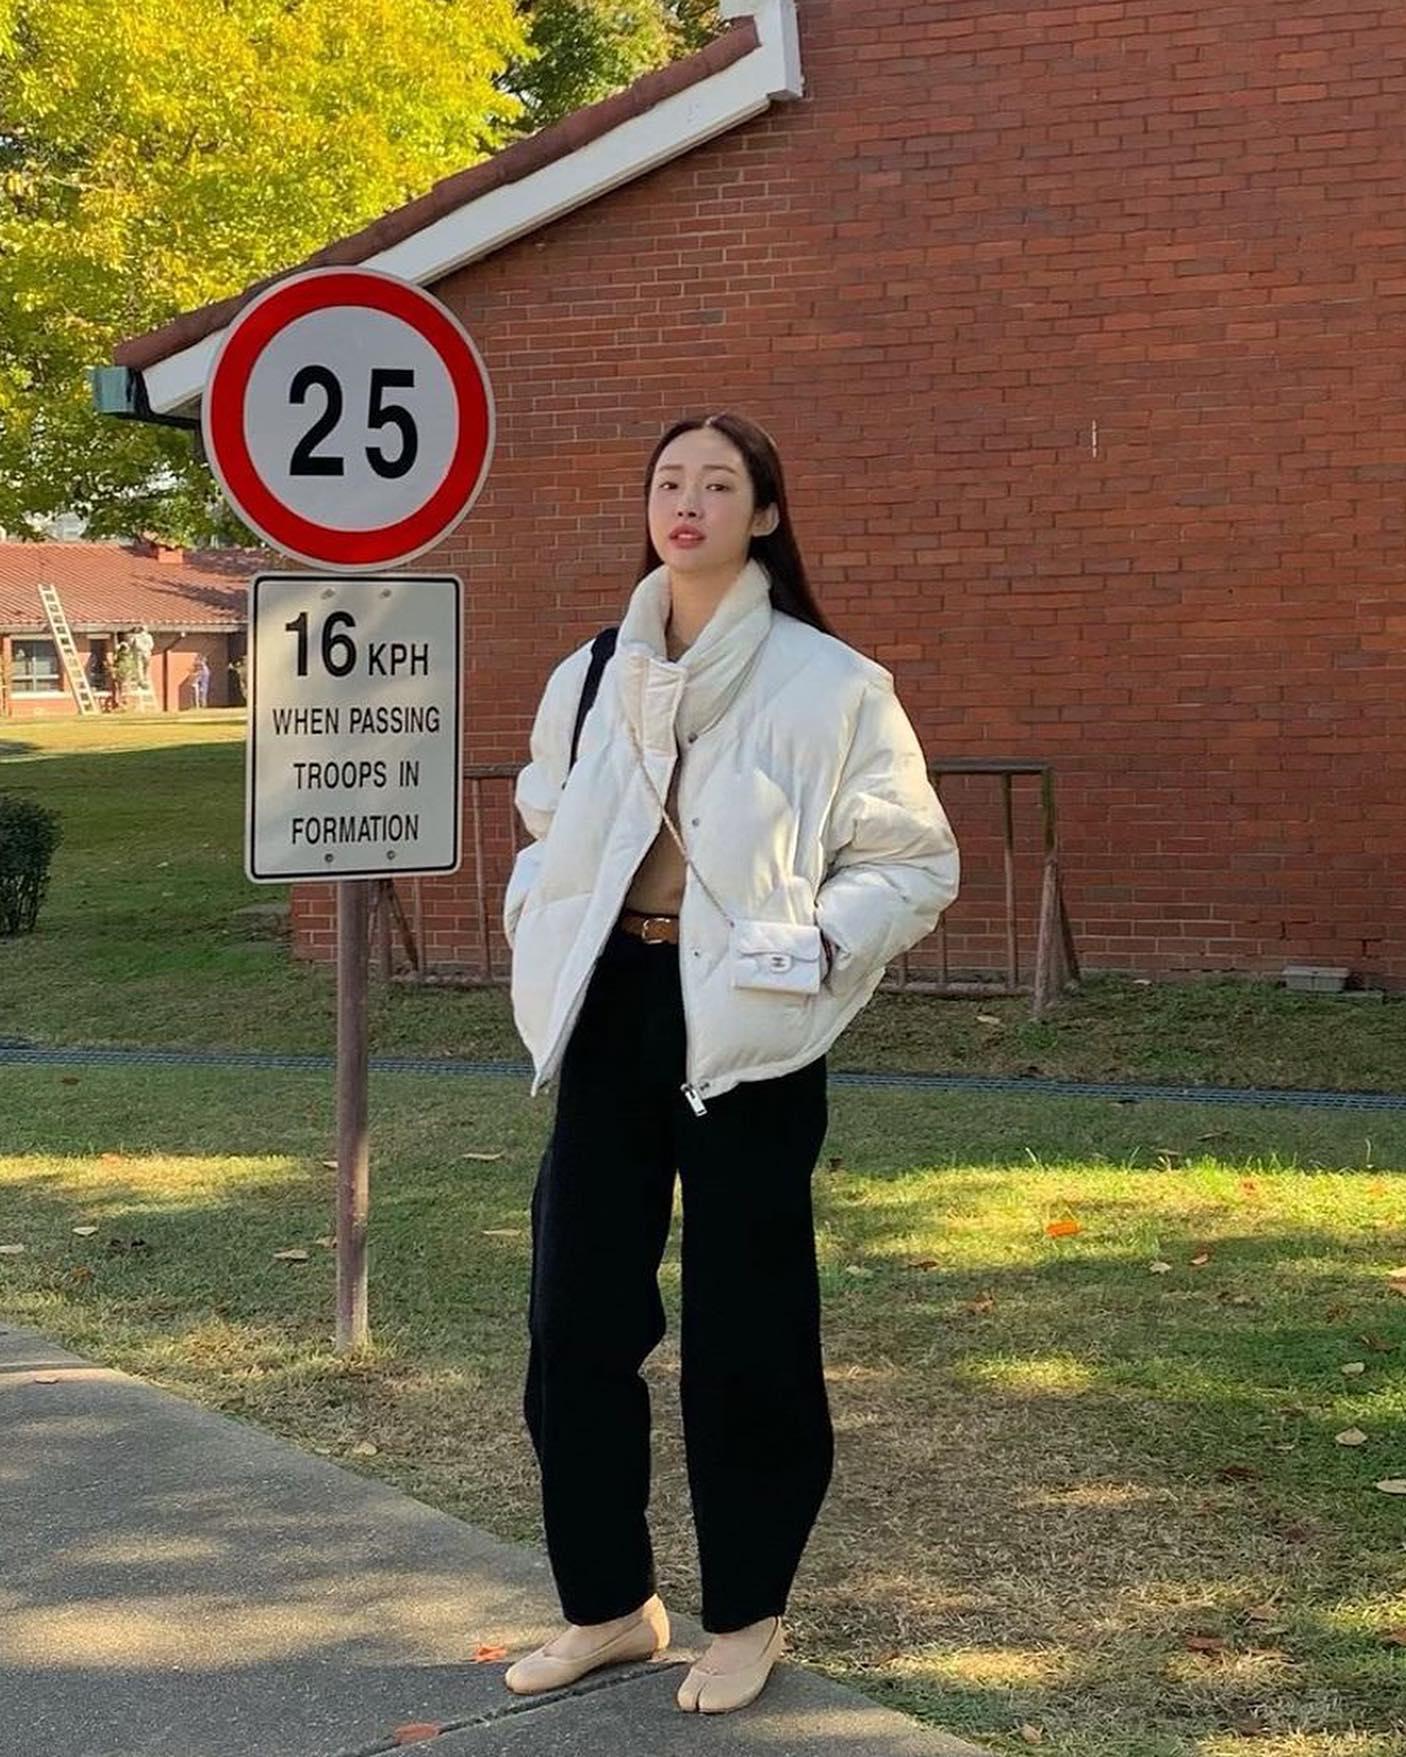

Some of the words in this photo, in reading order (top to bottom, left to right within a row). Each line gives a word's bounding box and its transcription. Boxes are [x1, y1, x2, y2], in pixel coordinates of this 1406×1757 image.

[288, 364, 419, 480] 25
[284, 610, 358, 678] 16
[368, 643, 429, 676] KPH
[272, 707, 340, 735] WHEN
[349, 706, 441, 734] PASSING
[293, 760, 388, 790] TROOPS
[399, 760, 420, 787] IN
[291, 814, 419, 845] FORMATION
